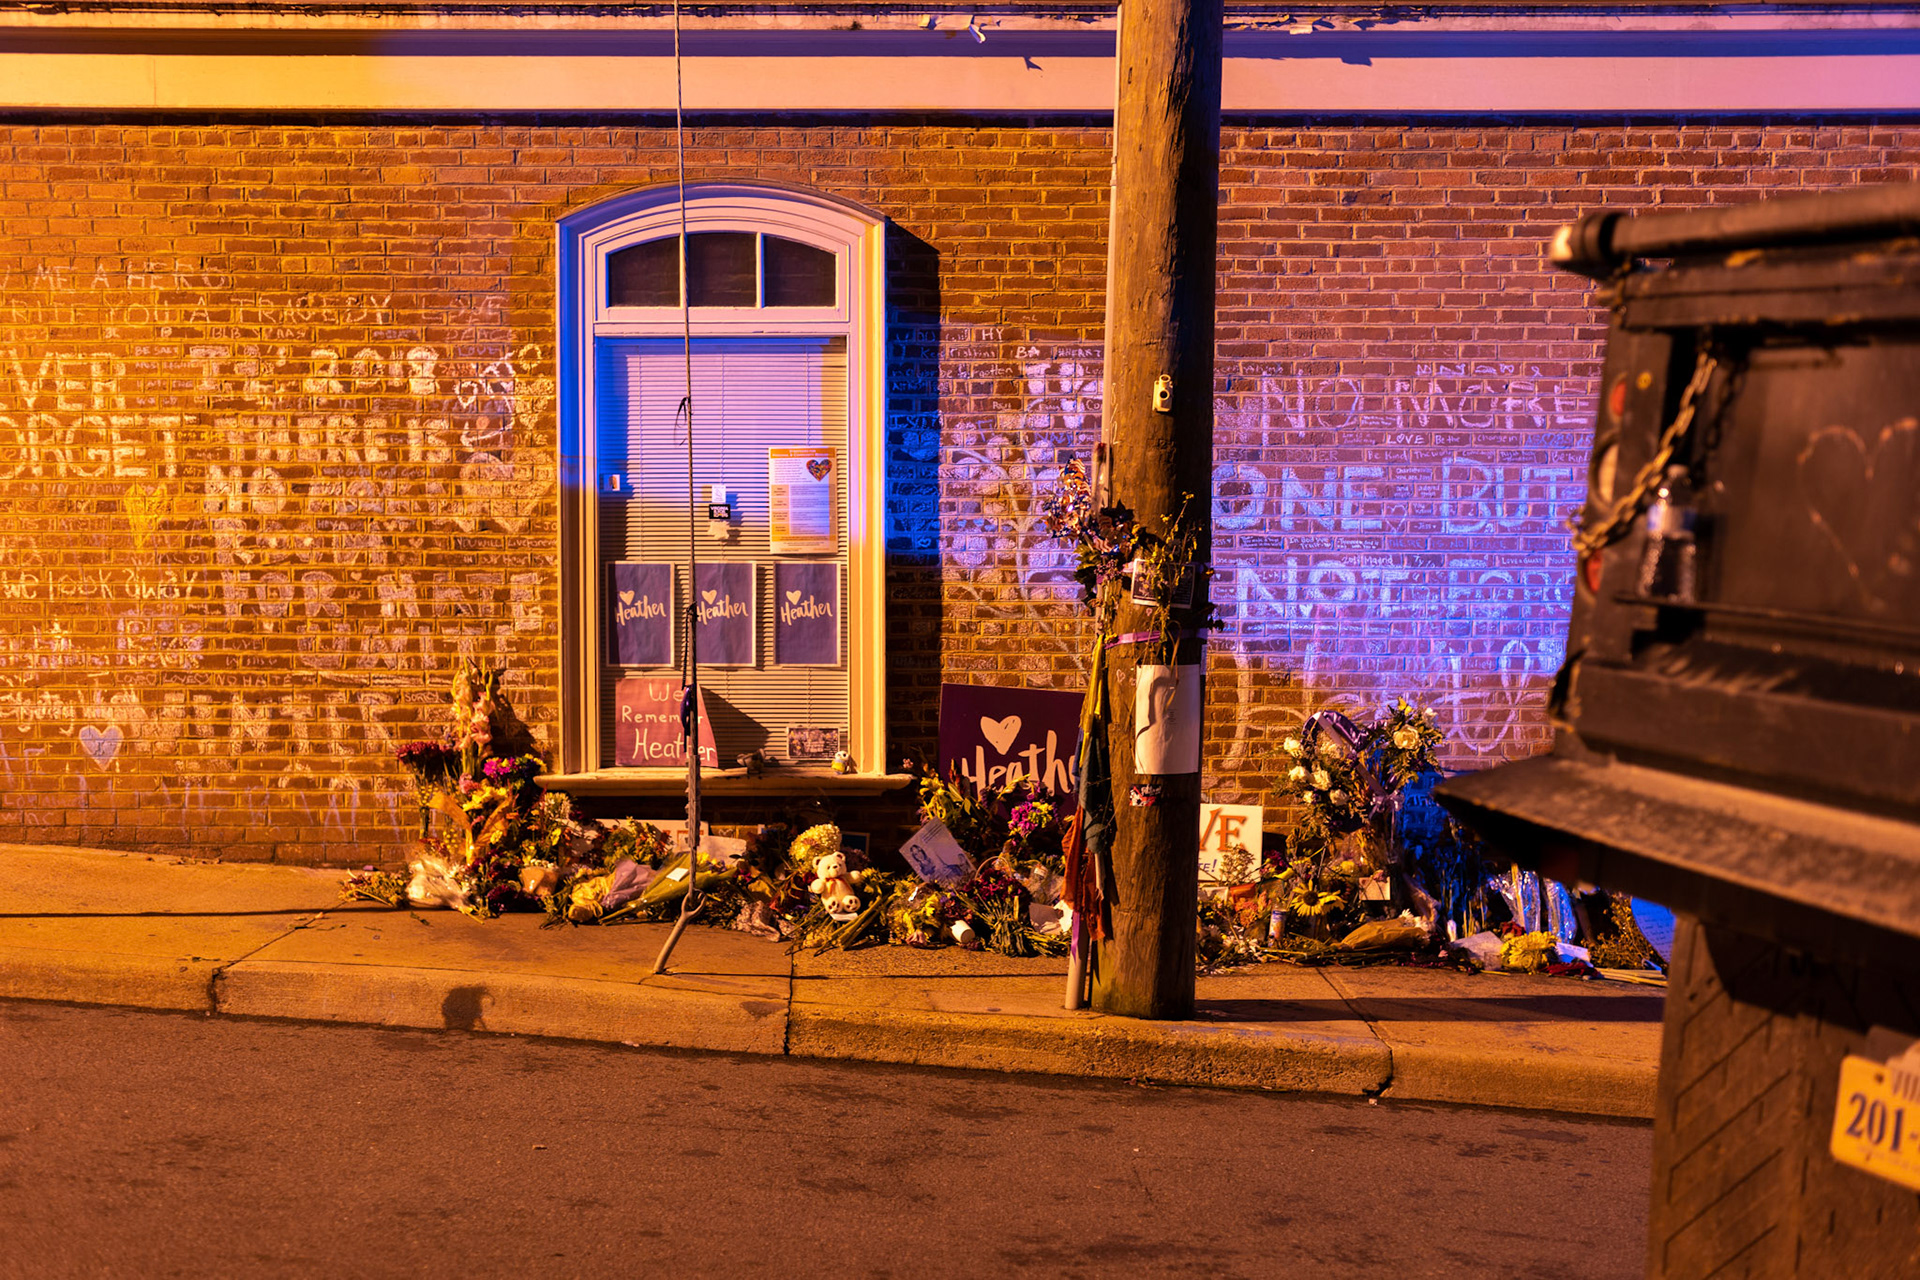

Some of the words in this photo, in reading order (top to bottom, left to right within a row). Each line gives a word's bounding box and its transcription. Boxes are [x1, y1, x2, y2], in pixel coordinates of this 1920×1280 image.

[1441, 456, 1573, 533] BUT
[47, 569, 113, 603] look
[220, 570, 343, 619] FOR
[376, 571, 543, 632] HATE
[616, 594, 667, 626] Heather
[696, 594, 748, 625] Heather
[780, 595, 833, 626] Heather
[215, 674, 237, 686] NO
[242, 674, 292, 687] HATE
[648, 682, 684, 702] We
[621, 705, 704, 725] Rememr
